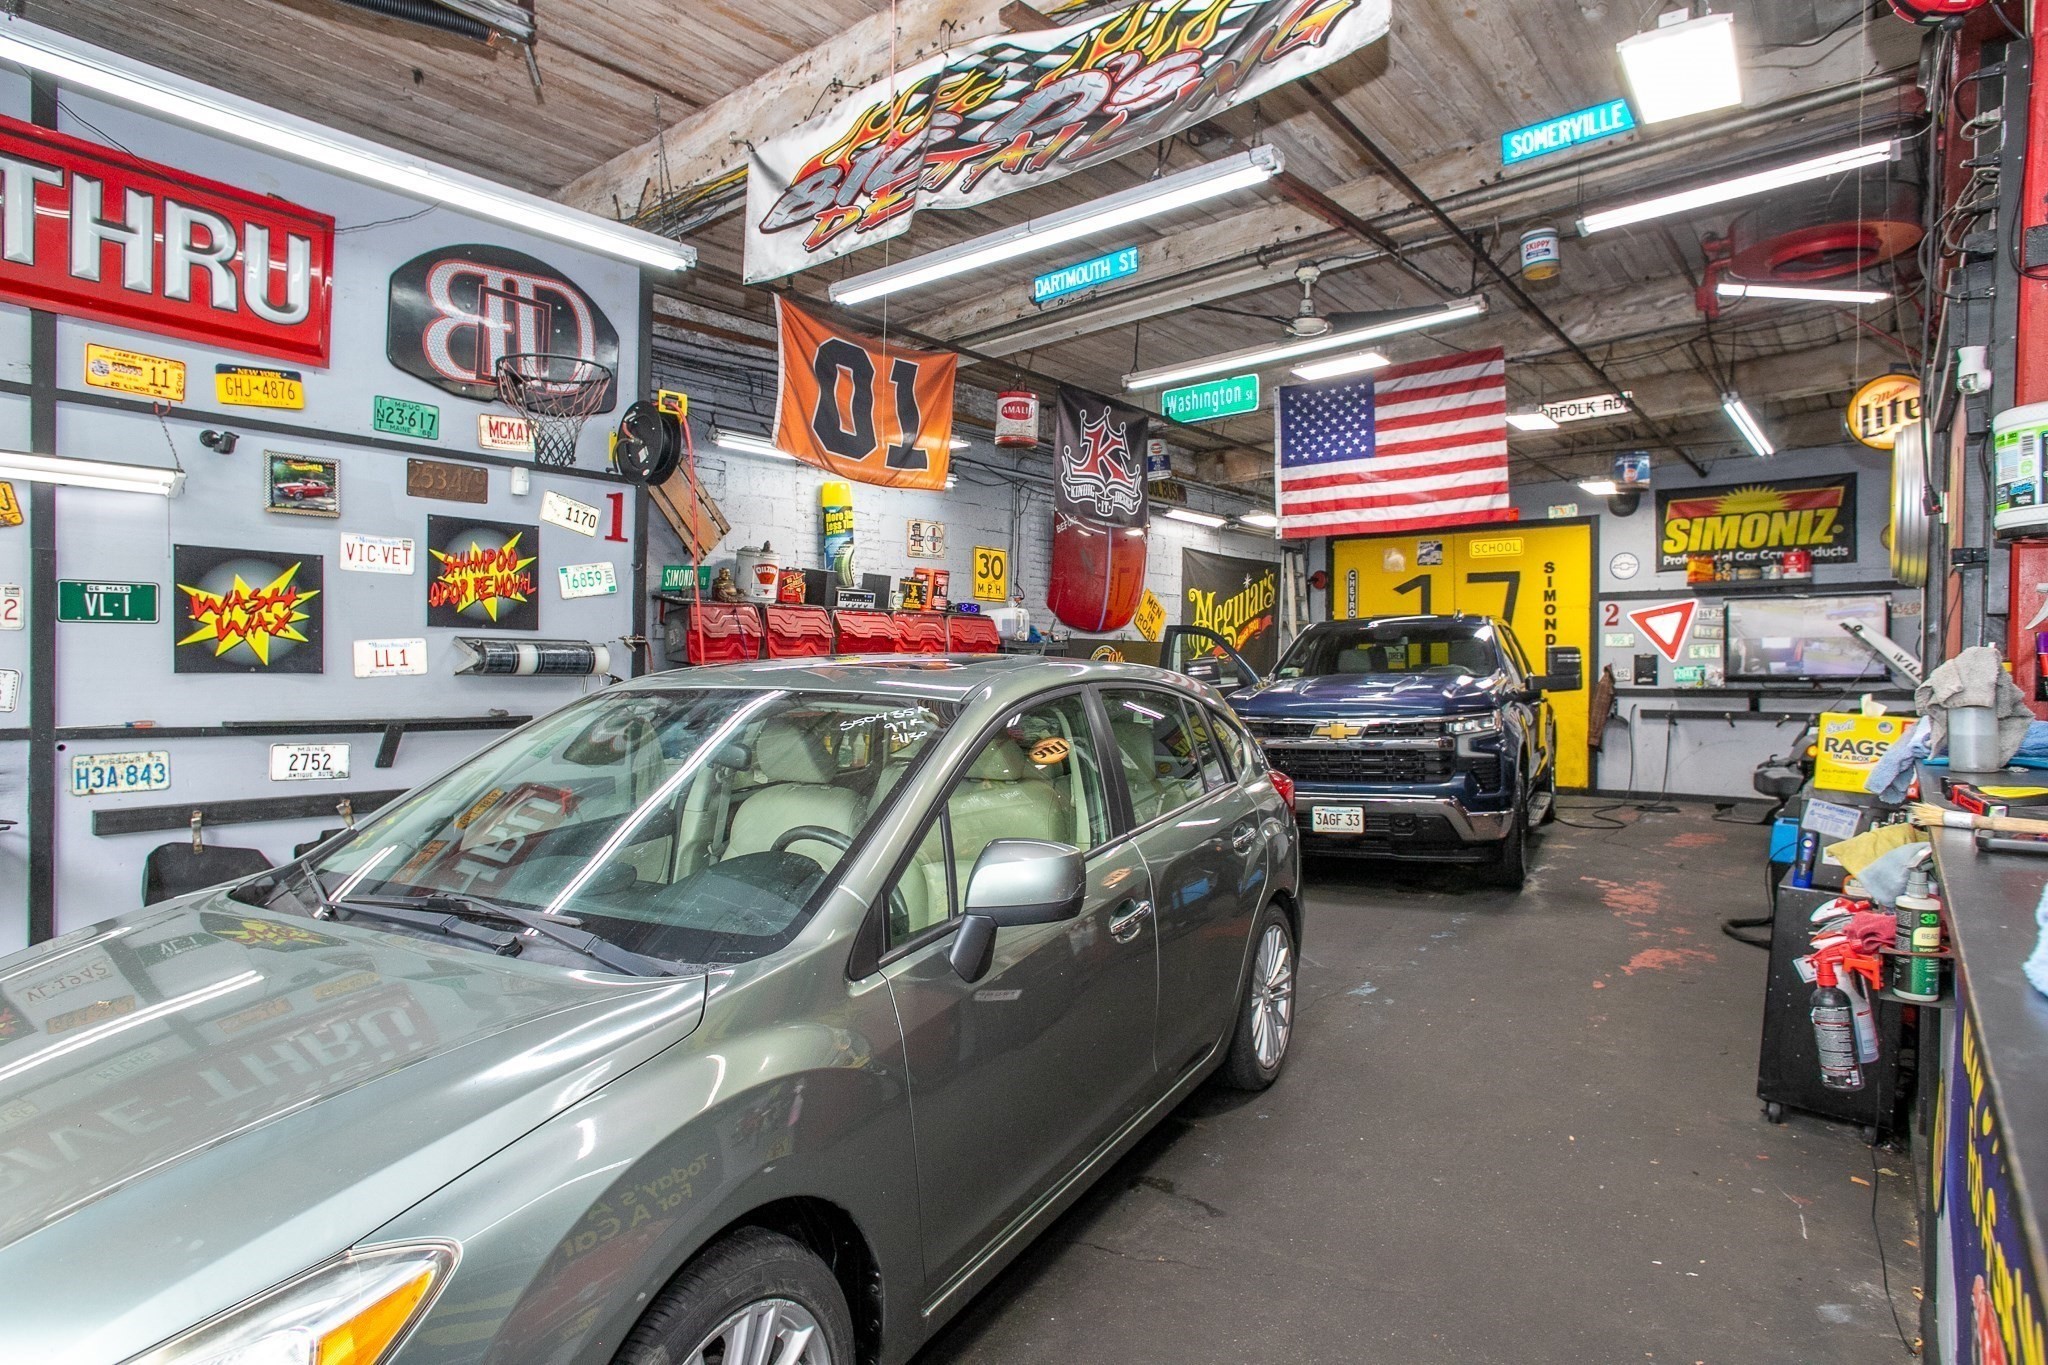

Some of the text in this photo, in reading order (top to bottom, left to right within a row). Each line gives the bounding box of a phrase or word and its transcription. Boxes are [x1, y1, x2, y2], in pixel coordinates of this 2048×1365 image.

[803, 0, 1354, 252] DETAILNG
[1510, 103, 1624, 158] SOMERVILLE
[0, 155, 311, 325] THRU
[1526, 240, 1549, 252] SKIPPY
[1035, 248, 1138, 298] DARTMOUTH ST
[149, 367, 170, 388] 11
[237, 368, 282, 379] NEW YORK
[811, 337, 928, 470] 01
[1002, 405, 1031, 414] AMALI
[1167, 386, 1241, 413] Washington
[1543, 400, 1595, 419] ORFOLK
[389, 424, 412, 434] MAINE
[1860, 397, 1920, 438] Lite
[1071, 484, 1095, 498] KINDIG
[566, 507, 597, 528] 1170
[1663, 507, 1841, 554] SIMONIZ
[1474, 542, 1520, 554] SCHOOL
[443, 547, 518, 578] SHAMPOO
[978, 554, 1003, 580] 30
[429, 571, 536, 607] ODOR REMOVAL
[565, 571, 602, 590] 16859
[665, 568, 697, 587] SIMOND
[190, 585, 297, 620] WASH
[1147, 596, 1162, 619] MEN
[1393, 570, 1521, 627] 17
[1147, 611, 1154, 624] IN
[1189, 569, 1275, 655] Meguiar's
[1604, 603, 1619, 626] 2
[215, 609, 294, 641] WAX
[1137, 614, 1157, 642] ROAD
[1824, 737, 1890, 757] RAGS
[100, 756, 144, 765] MISSOURI
[289, 753, 331, 771] 2752
[1315, 813, 1360, 826] 3AGF 33
[1920, 913, 1938, 924] 3D
